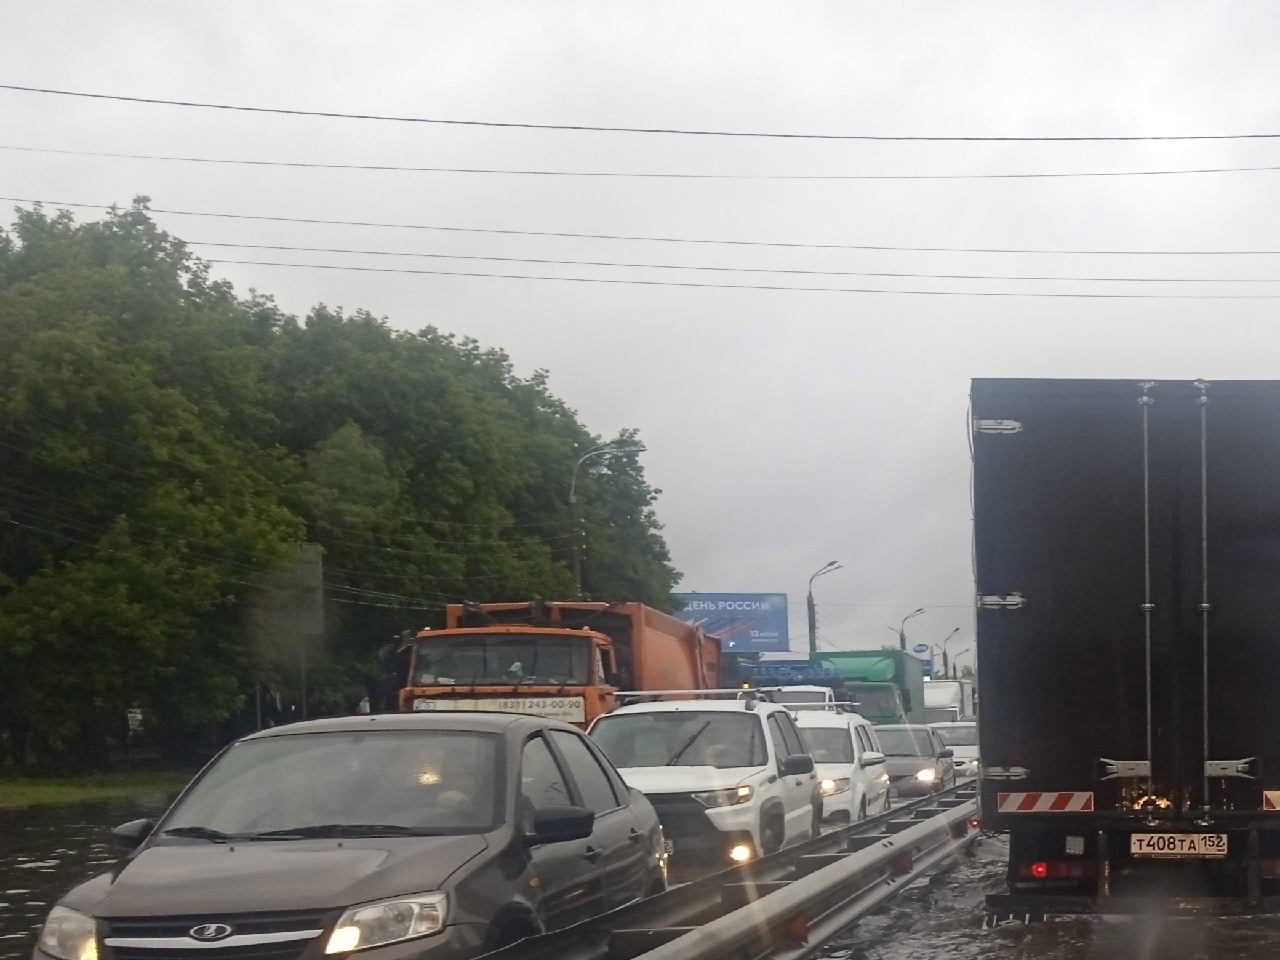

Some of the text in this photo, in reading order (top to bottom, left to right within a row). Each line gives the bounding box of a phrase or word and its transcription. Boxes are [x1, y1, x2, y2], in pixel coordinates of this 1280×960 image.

[683, 601, 770, 612] ДЕНЬ РОССИИ
[498, 700, 582, 711] (831) 243-00-90
[1201, 835, 1224, 848] 152
